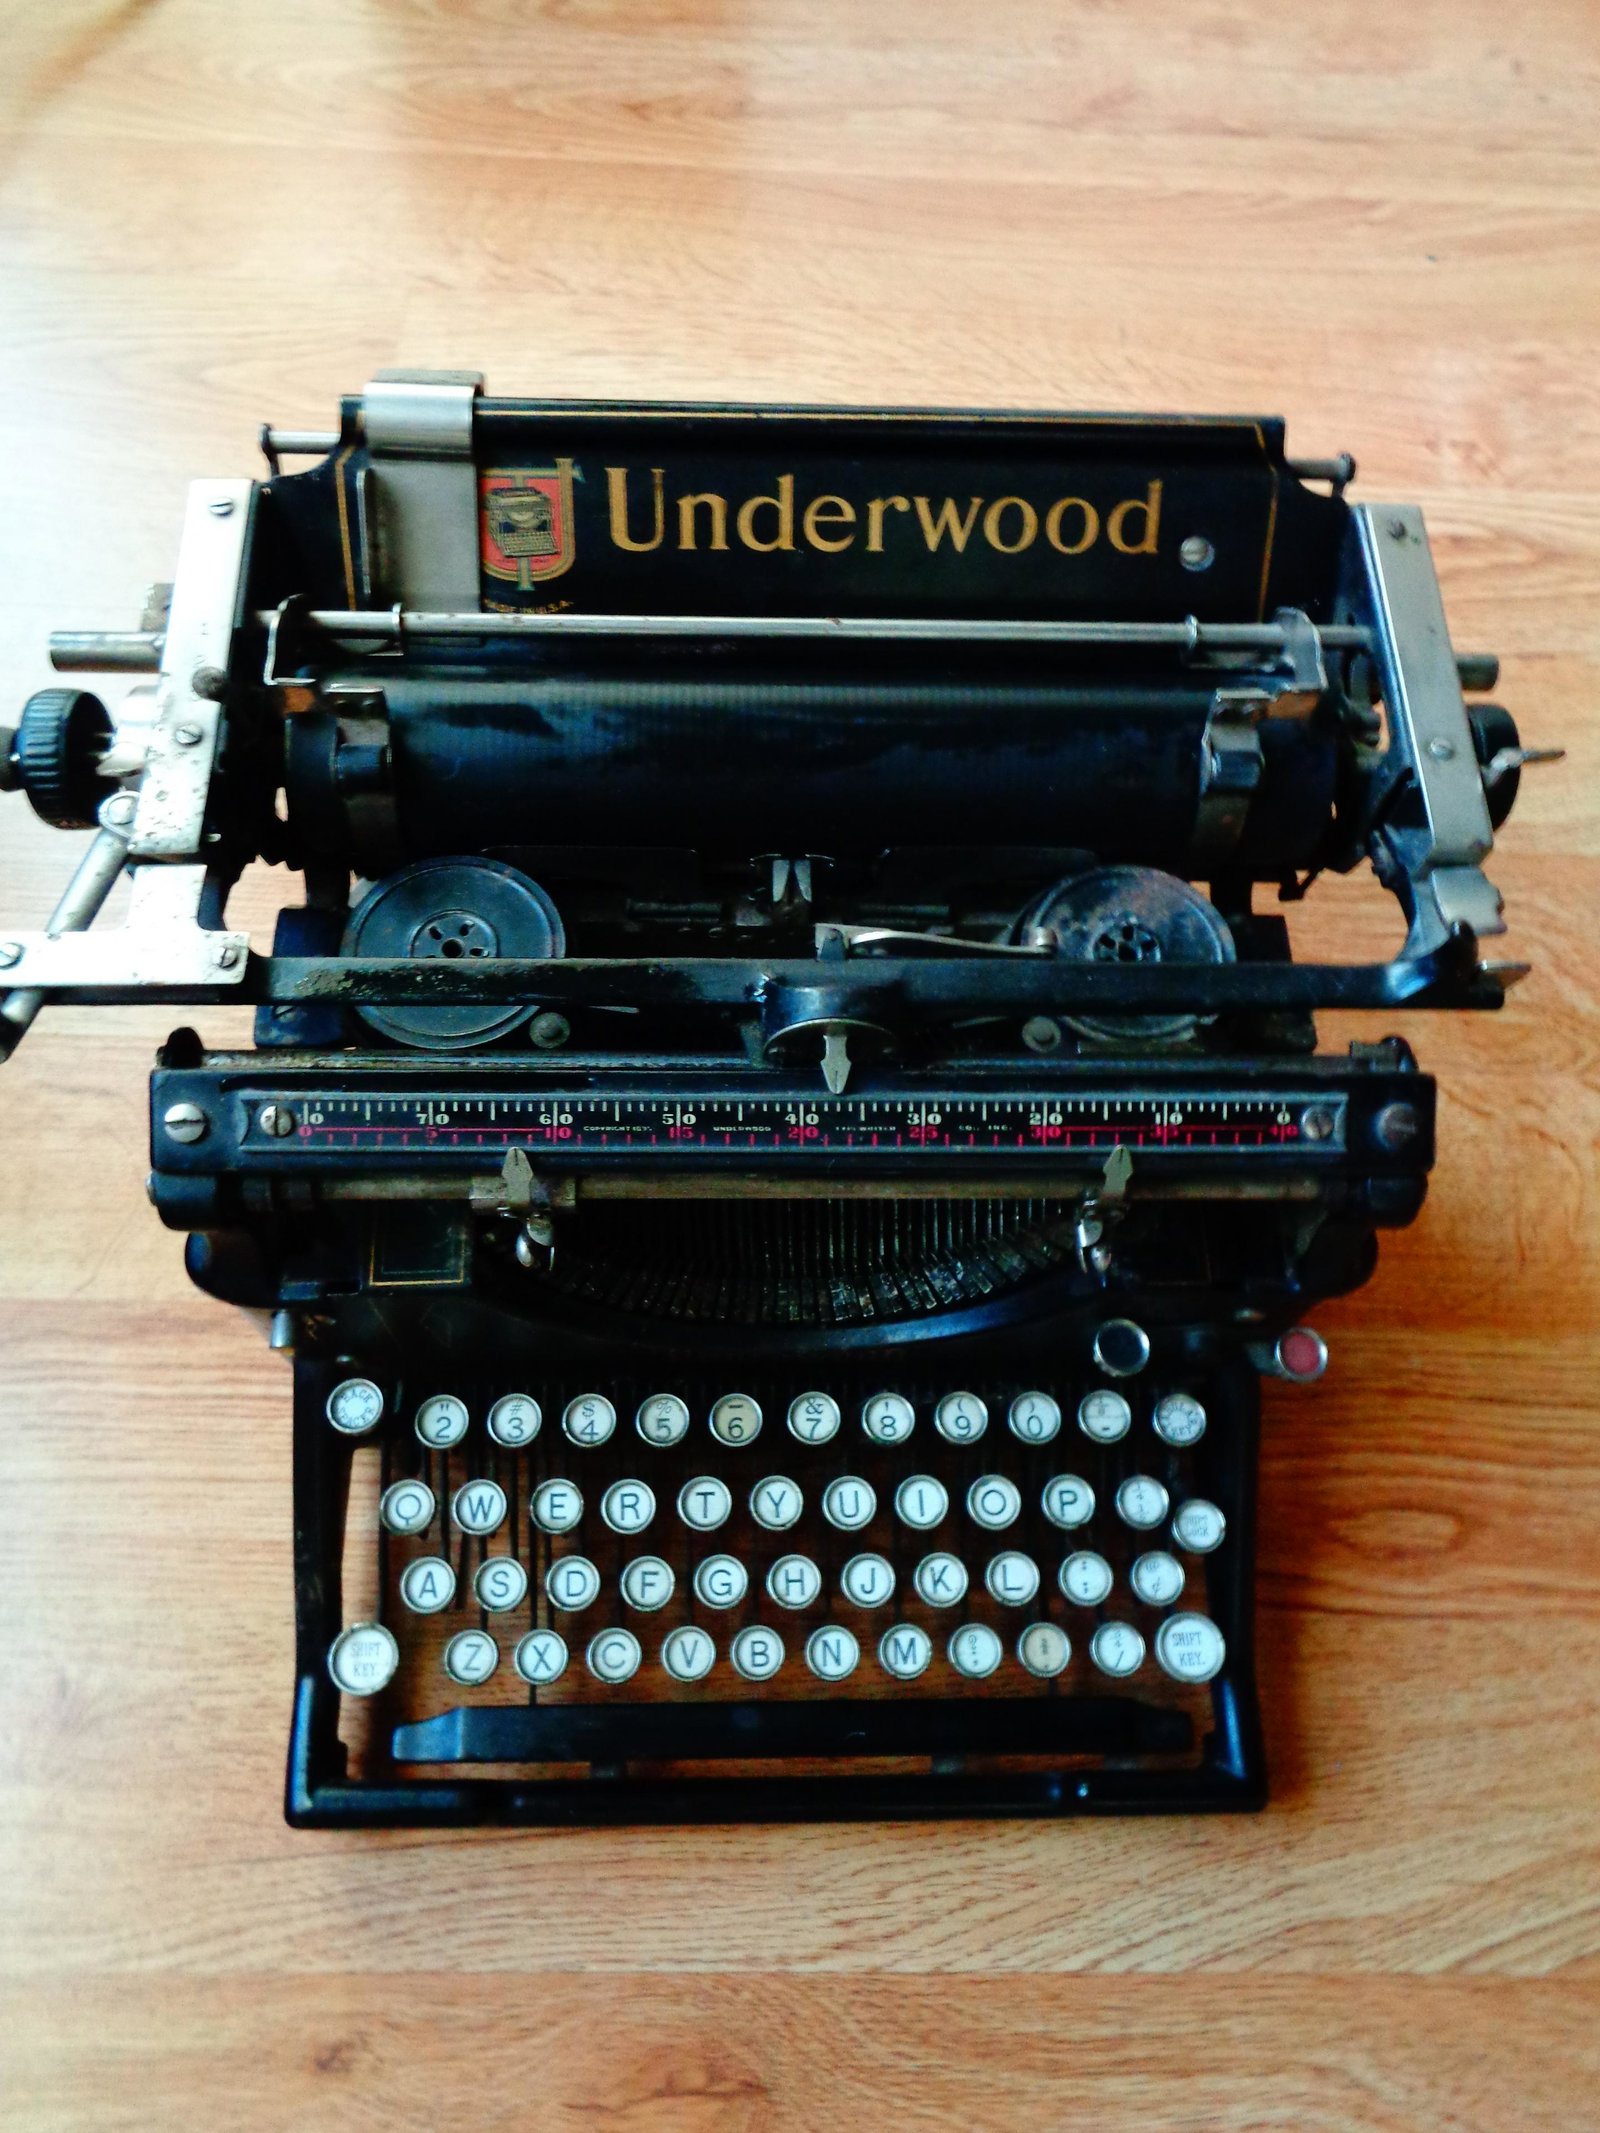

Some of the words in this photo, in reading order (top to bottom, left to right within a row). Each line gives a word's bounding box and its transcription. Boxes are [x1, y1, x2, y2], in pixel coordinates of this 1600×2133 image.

[605, 467, 1163, 554] Underwood
[416, 1113, 450, 1125] 70
[540, 1113, 573, 1125] 60
[662, 1113, 697, 1125] 50
[785, 1113, 819, 1125] 40
[907, 1113, 942, 1125] 30
[1029, 1112, 1063, 1125] 20
[1155, 1112, 1183, 1125] 10
[1277, 1112, 1291, 1125] 0
[436, 1416, 452, 1439] 2
[507, 1417, 524, 1439] 3
[580, 1419, 600, 1440] 4
[655, 1418, 673, 1440] 5
[727, 1417, 744, 1439] 6
[805, 1417, 822, 1440] 7
[880, 1415, 897, 1437] 8
[955, 1415, 972, 1437] 9
[1027, 1414, 1043, 1437] 0
[395, 1493, 423, 1526] Q
[468, 1494, 495, 1523] W
[549, 1493, 568, 1521] E
[619, 1493, 641, 1520] R
[695, 1491, 716, 1519] T
[766, 1491, 789, 1518] Y
[838, 1490, 860, 1518] U
[917, 1489, 925, 1517] I
[981, 1489, 1007, 1516] O
[1058, 1489, 1079, 1517] P
[418, 1571, 438, 1599] A
[490, 1571, 510, 1598] S
[565, 1570, 588, 1597] D
[640, 1571, 660, 1598] F
[708, 1569, 733, 1597] G
[785, 1568, 806, 1596] H
[860, 1567, 876, 1595] J
[929, 1565, 953, 1594] K
[1002, 1563, 1022, 1591] L
[893, 1638, 918, 1665] M
[1171, 1631, 1202, 1647] SHIFT
[462, 1643, 483, 1671] Z
[532, 1643, 552, 1672] X
[600, 1641, 627, 1670] C
[679, 1641, 699, 1669] V
[750, 1640, 771, 1668] B
[822, 1639, 842, 1667] N
